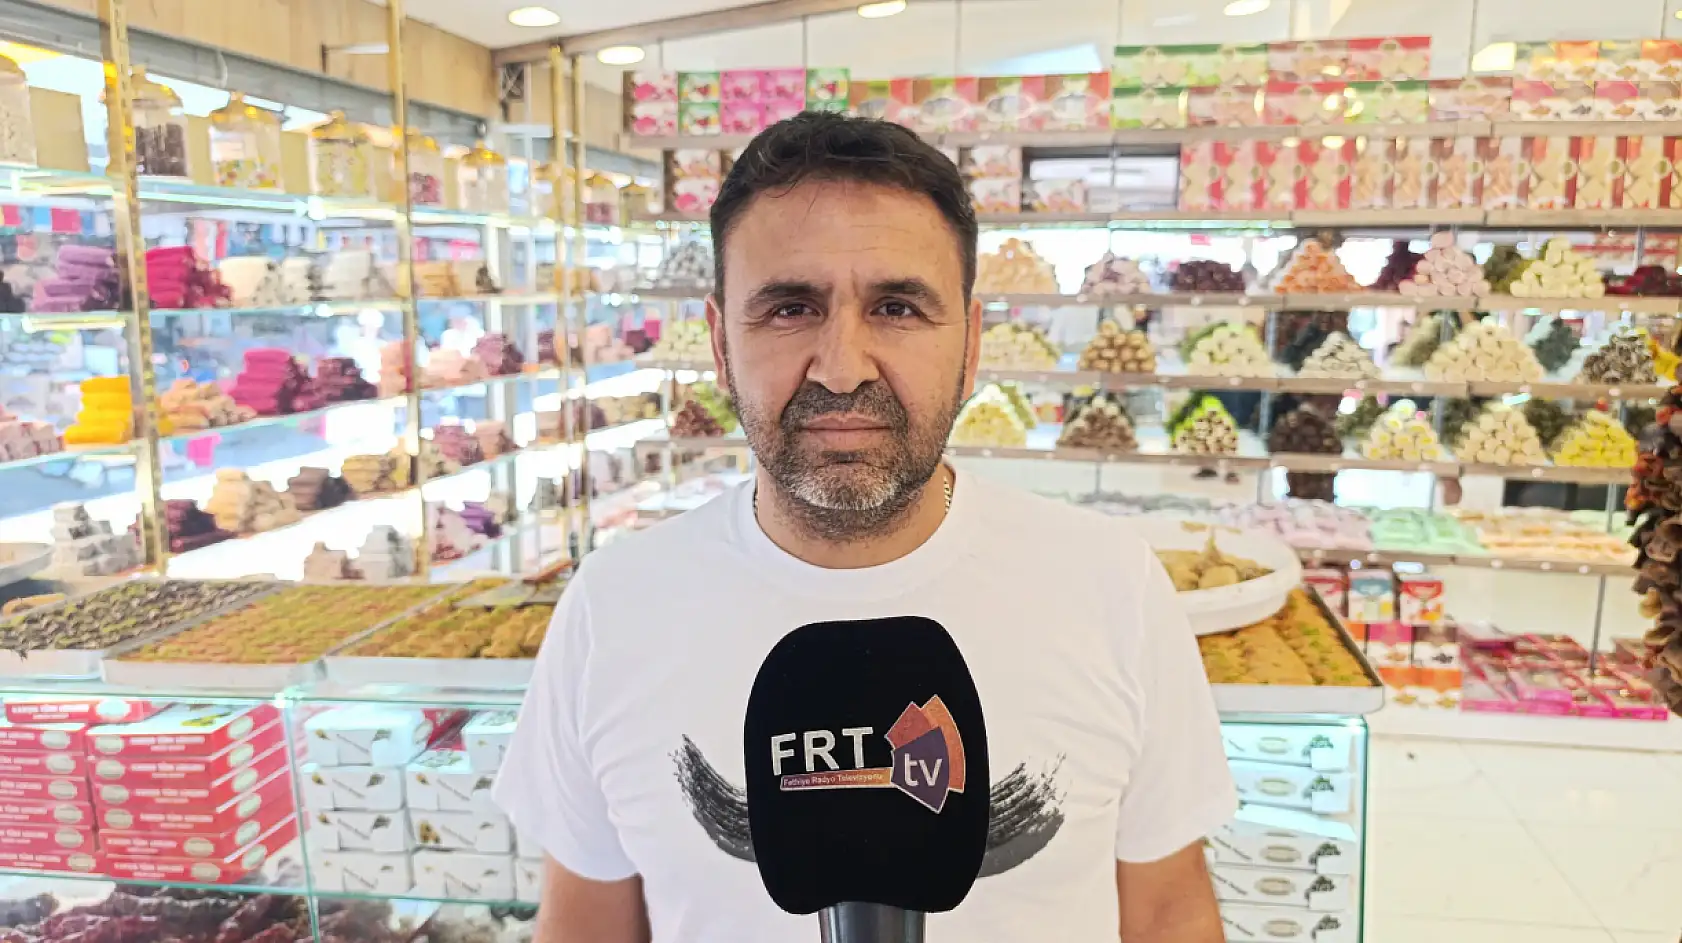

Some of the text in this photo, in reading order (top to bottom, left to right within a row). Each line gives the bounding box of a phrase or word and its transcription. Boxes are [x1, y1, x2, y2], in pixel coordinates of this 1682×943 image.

[771, 726, 874, 776] FRT
[783, 777, 811, 788] Fethiye
[812, 774, 836, 786] Radyo
[904, 752, 943, 787] tv
